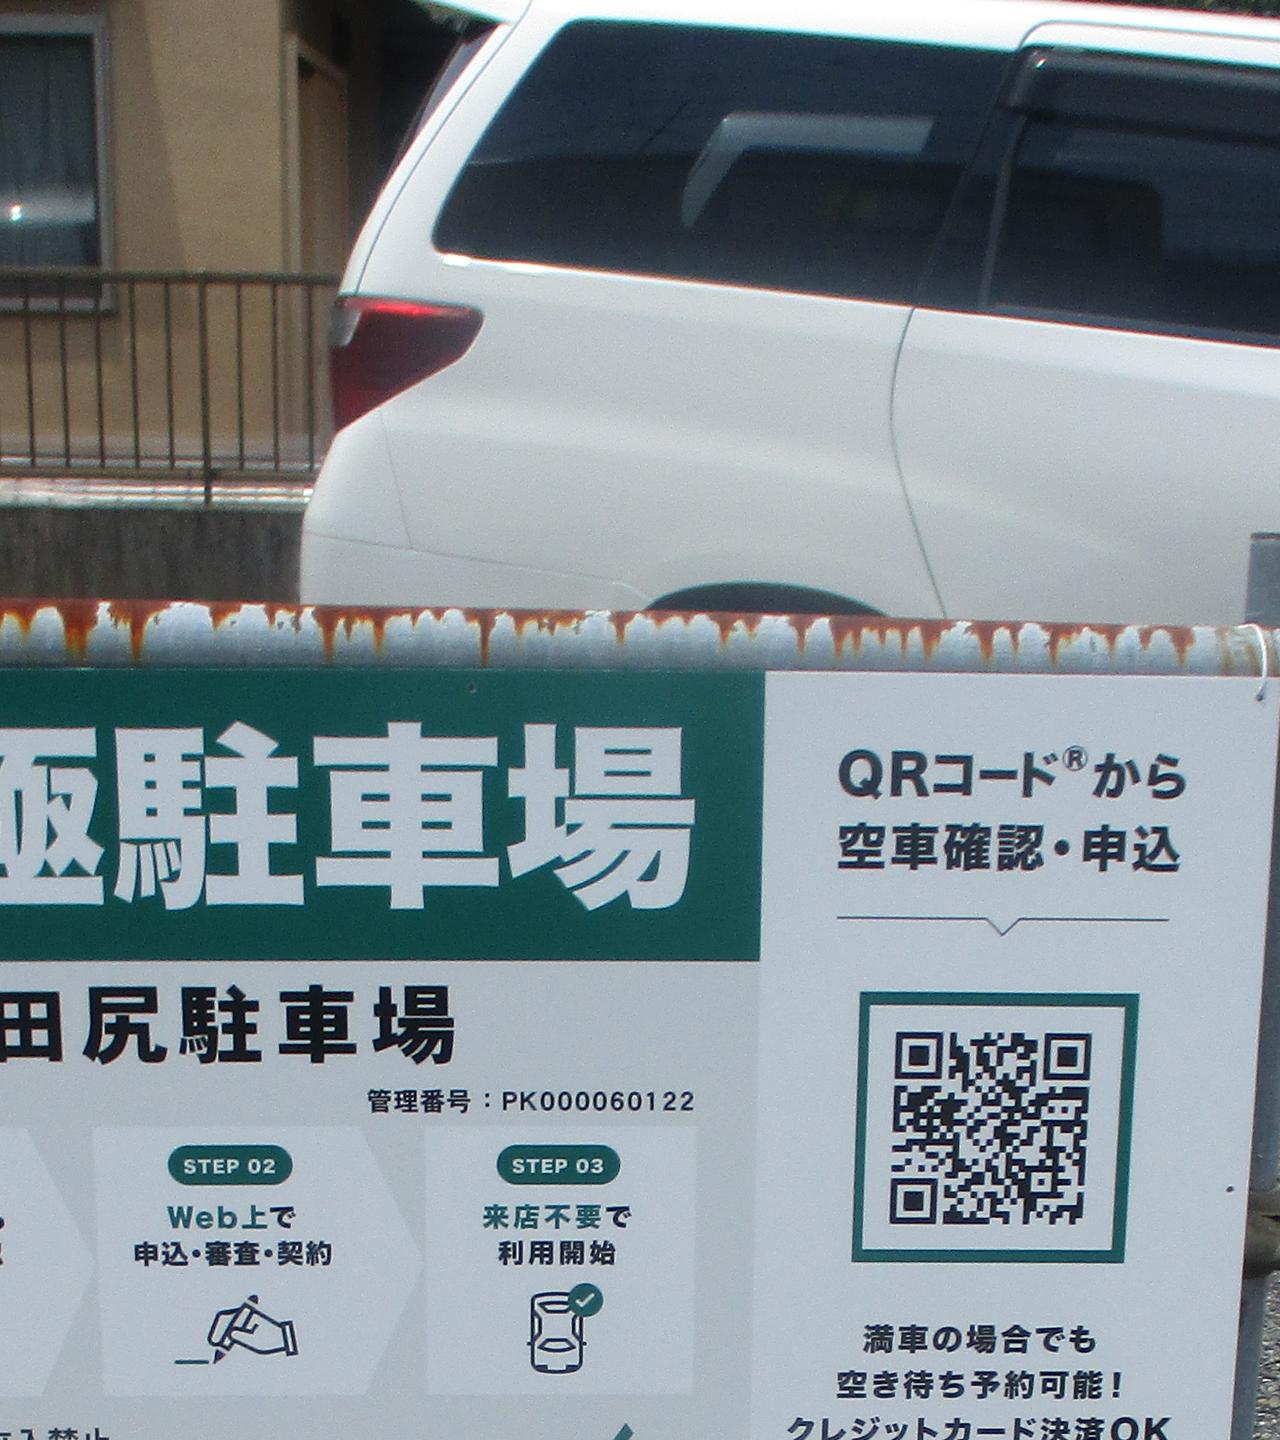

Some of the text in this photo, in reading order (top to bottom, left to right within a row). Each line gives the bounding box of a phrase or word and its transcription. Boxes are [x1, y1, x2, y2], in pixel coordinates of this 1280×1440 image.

[837, 822, 1181, 873] 空車確認・申込
[183, 1158, 277, 1175] STEP 02
[511, 1157, 605, 1175] STEP 03
[166, 1204, 297, 1230] Web上で
[482, 1203, 632, 1230] 来店不要で
[133, 1240, 333, 1267] 申込・審査・契約
[497, 1239, 617, 1266] 利用開始
[862, 1324, 1097, 1354] 満車の場合でも
[835, 1370, 1122, 1400] 空き待ち予約可能!
